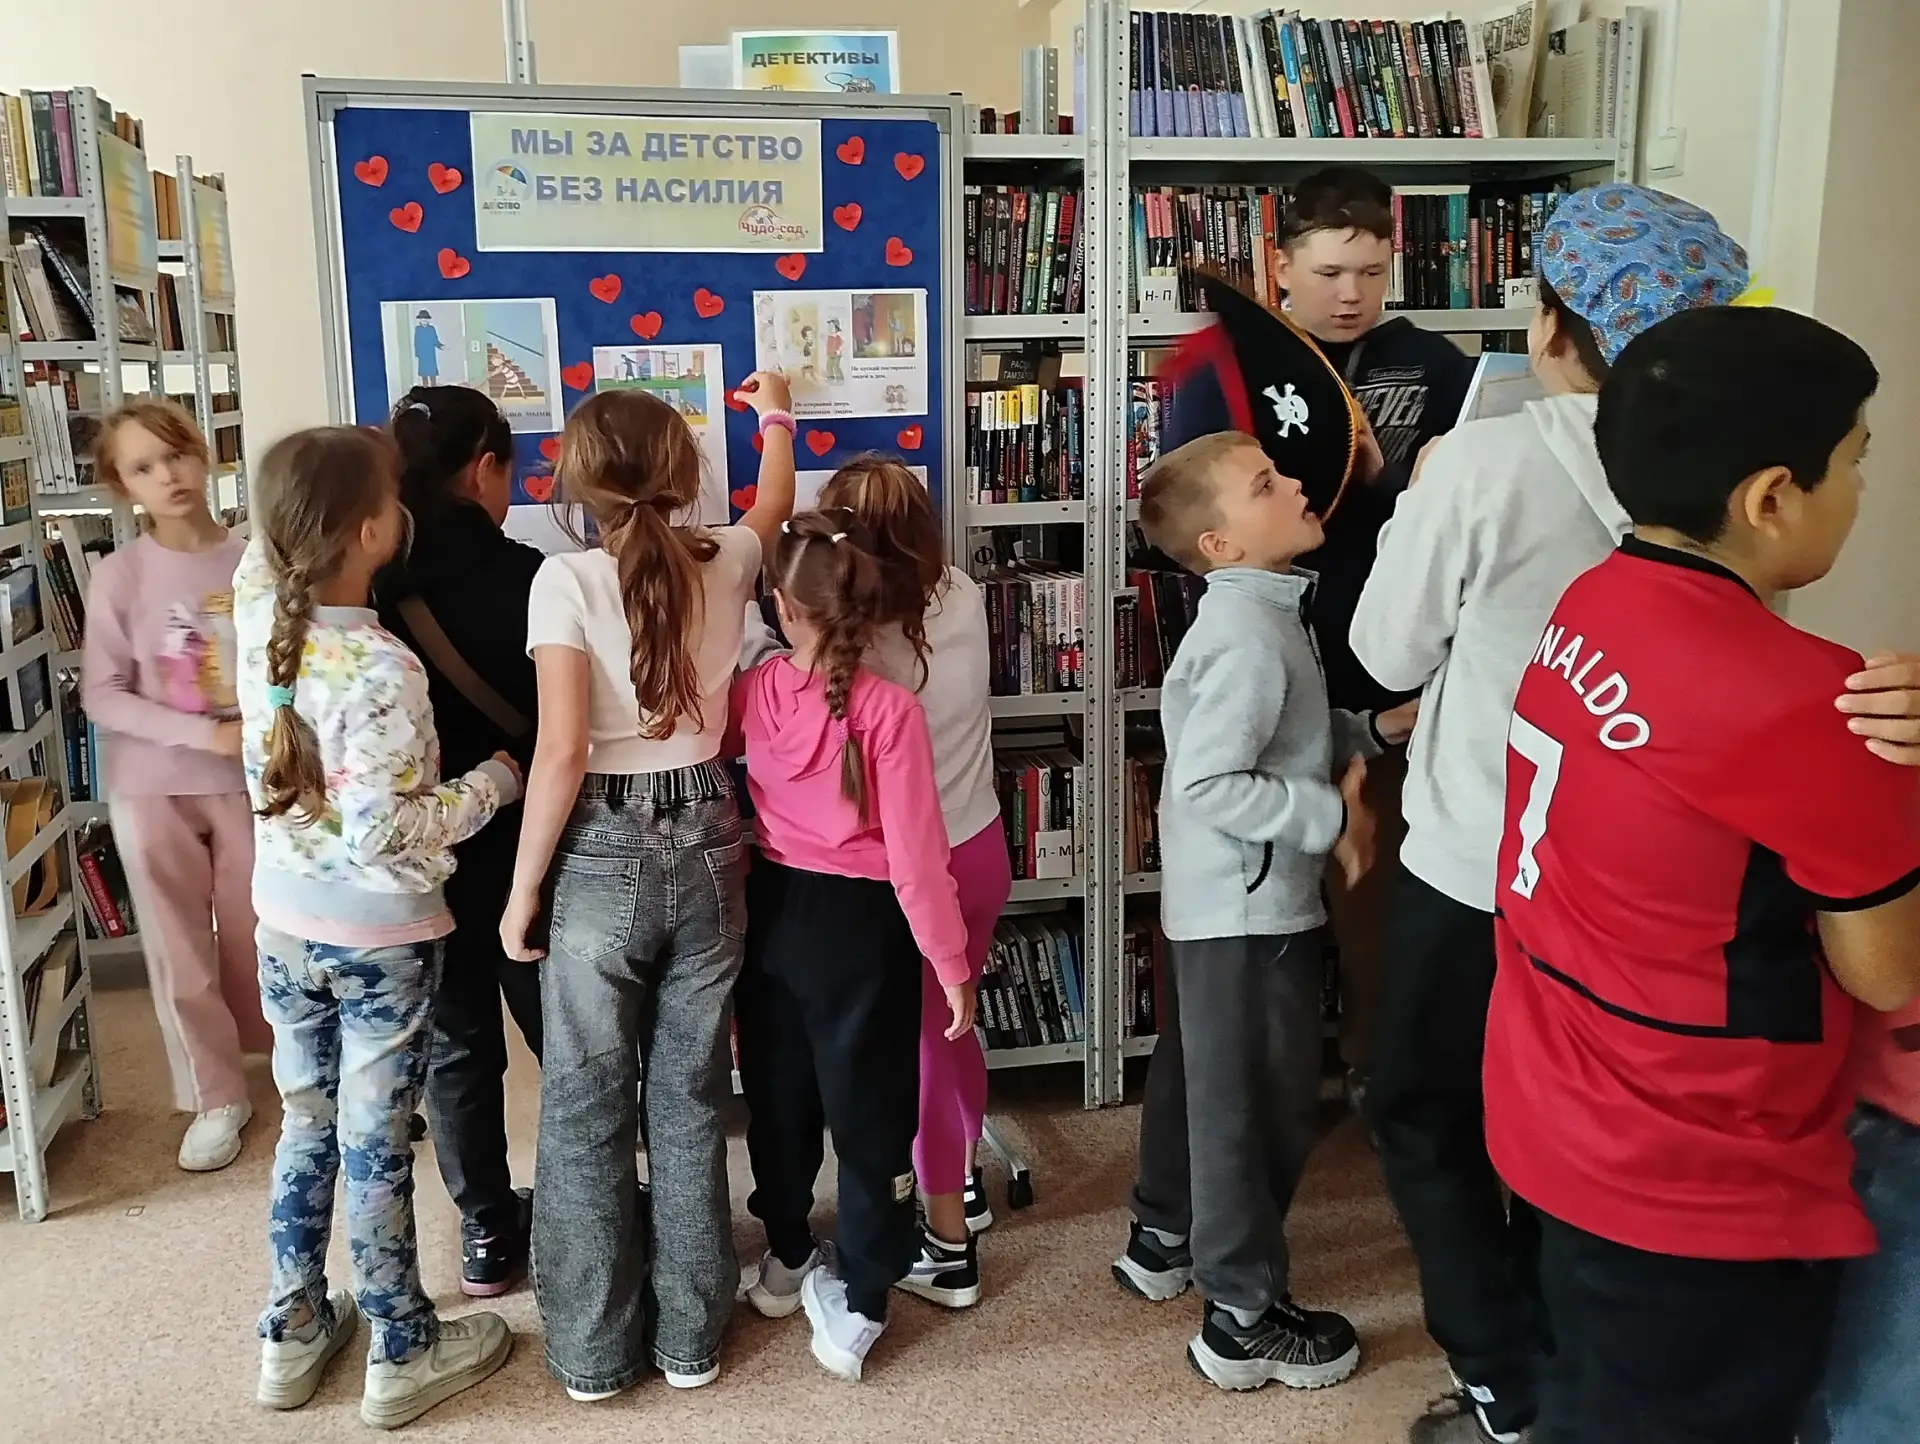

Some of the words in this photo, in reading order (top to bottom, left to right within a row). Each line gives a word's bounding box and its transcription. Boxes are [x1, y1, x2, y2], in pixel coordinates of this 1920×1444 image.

[751, 51, 880, 68] ДЕТЕКТИВЫ
[511, 128, 573, 157] МЫ
[586, 131, 632, 157] ЗА
[642, 133, 803, 163] ДЕТСТВО
[535, 175, 602, 202] БЕЗ
[615, 177, 783, 205] НАСИЛИЯ
[1045, 202, 1058, 235] БУШКОВ
[1213, 200, 1226, 253] НЕЗНАНСКИЙ
[974, 545, 994, 566] Ф
[1061, 655, 1069, 686] КОЛЫЧЕВ
[1509, 709, 1564, 900] 7
